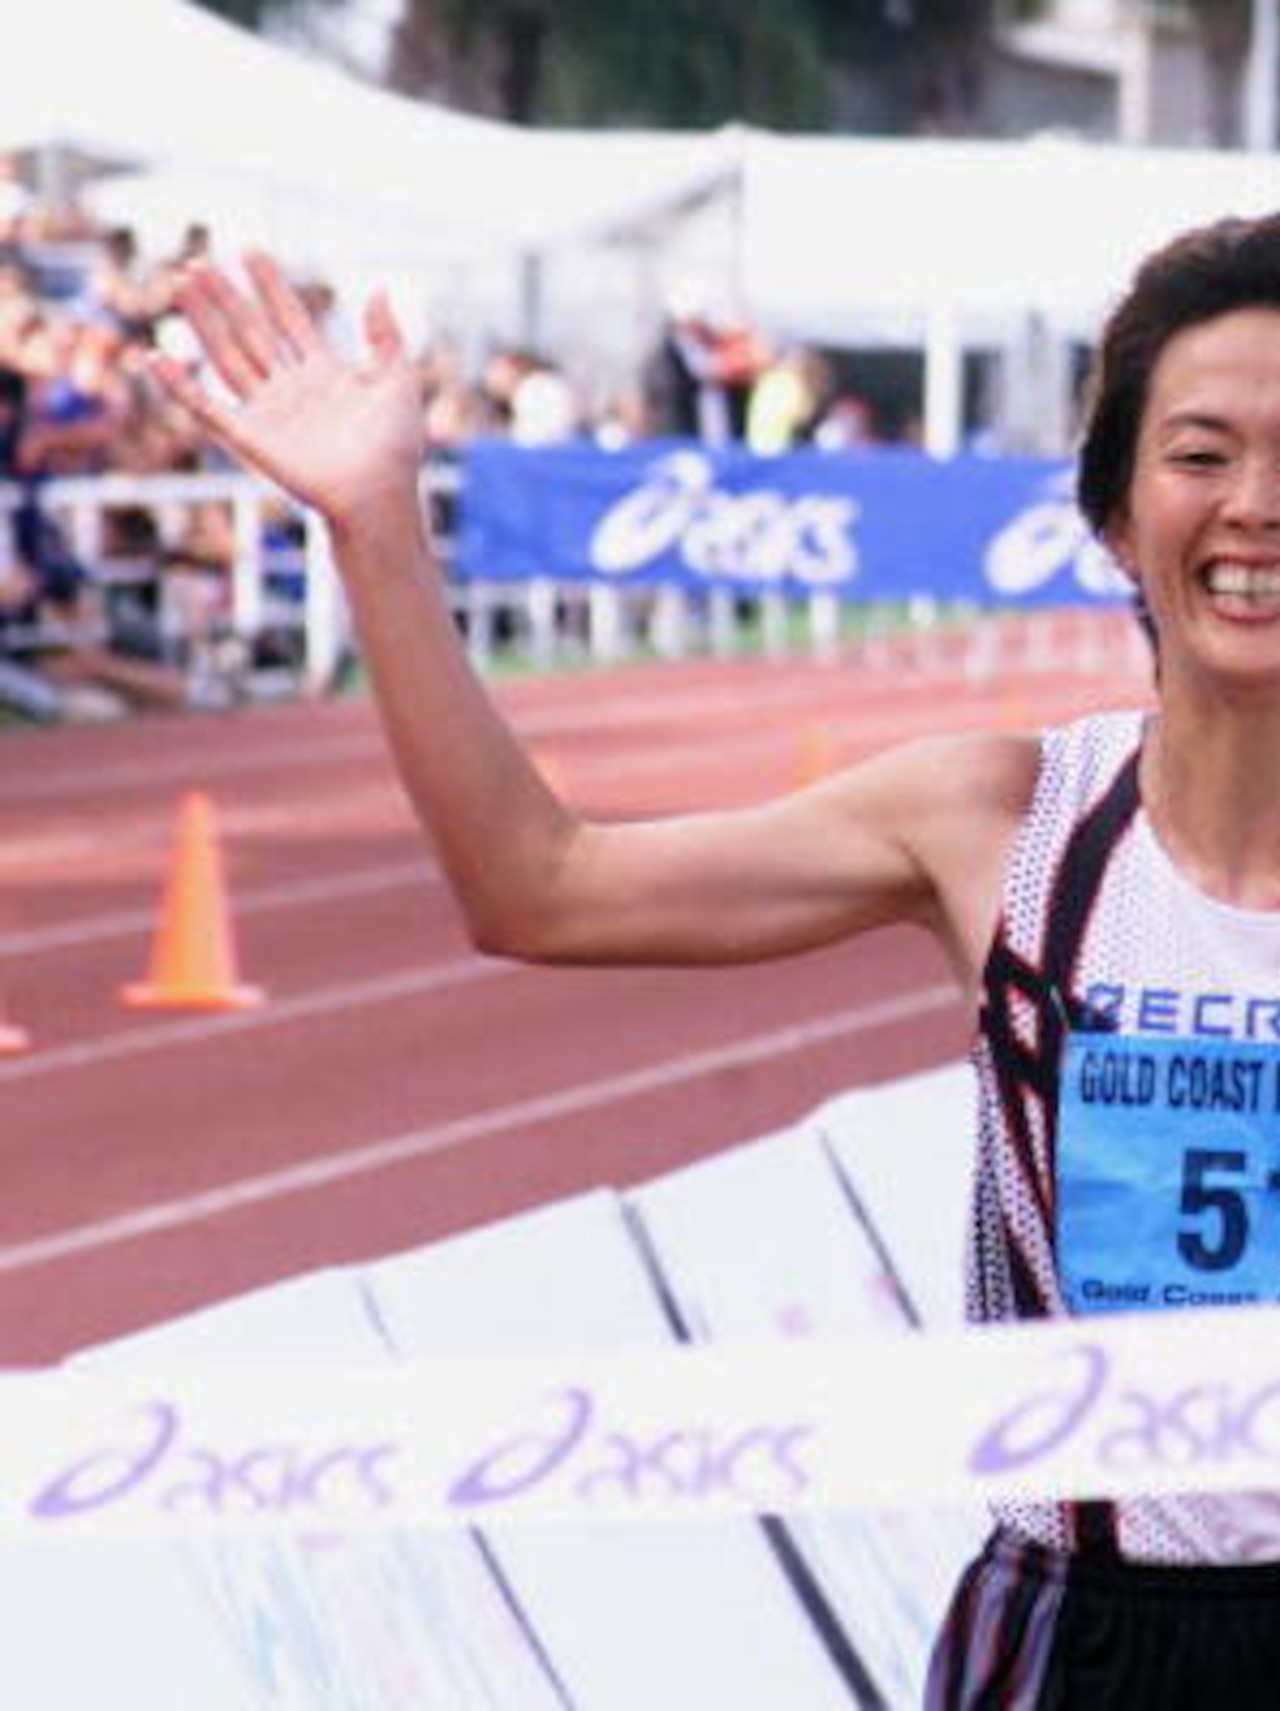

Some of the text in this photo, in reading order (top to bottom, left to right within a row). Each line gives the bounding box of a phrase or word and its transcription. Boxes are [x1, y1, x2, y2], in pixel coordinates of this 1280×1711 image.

[1080, 1051, 1155, 1106] GOLD
[1167, 1055, 1264, 1112] COAST
[1081, 1279, 1149, 1302] Gold
